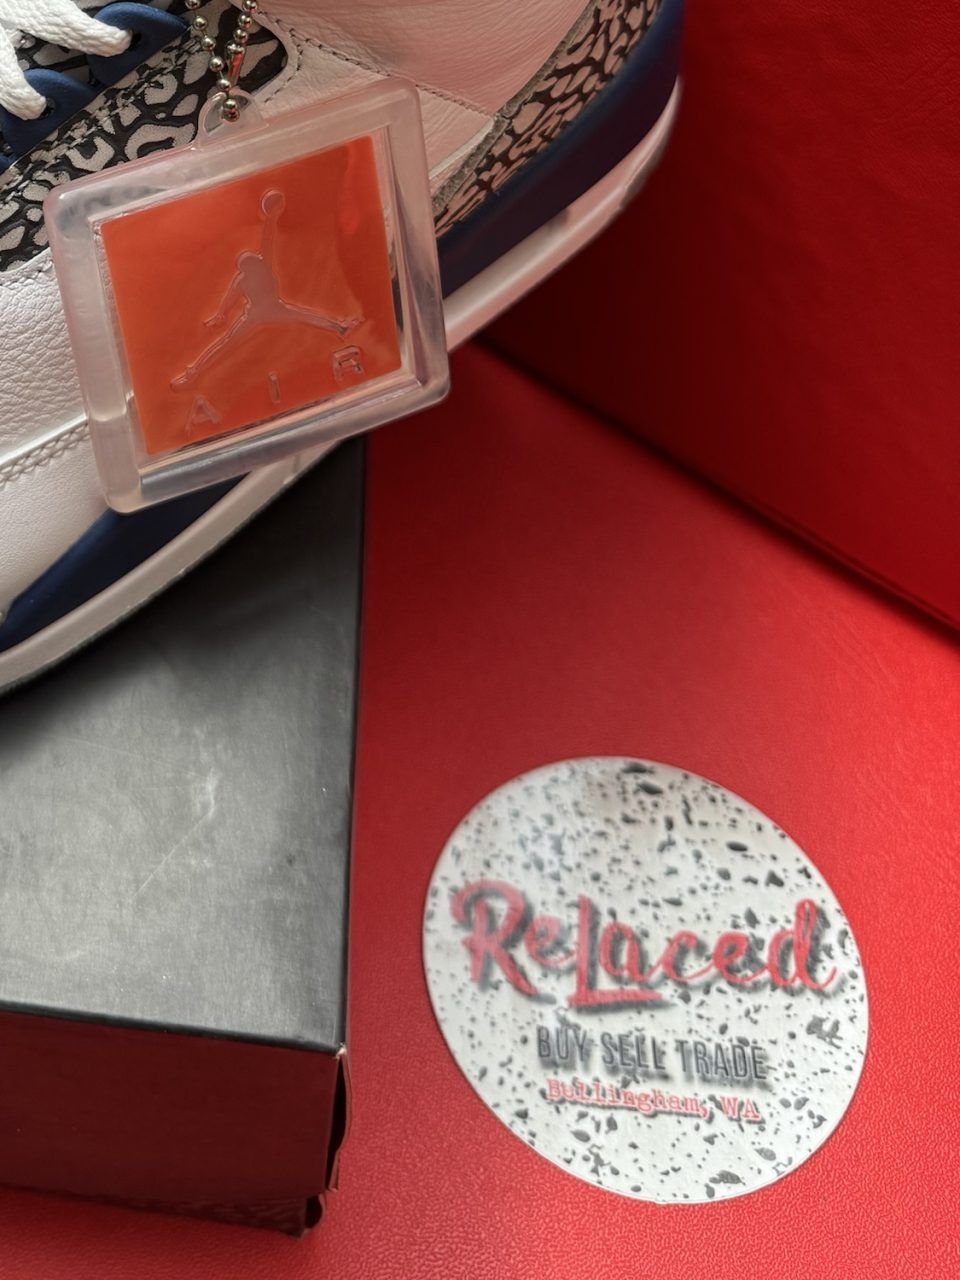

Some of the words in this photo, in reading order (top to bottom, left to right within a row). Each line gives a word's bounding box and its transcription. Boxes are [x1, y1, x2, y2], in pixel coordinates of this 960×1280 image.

[184, 345, 365, 438] AIR
[449, 878, 838, 1007] ReLaced
[536, 1025, 587, 1063] BUY
[600, 1031, 667, 1071] SELL
[675, 1038, 768, 1081] TRADE
[719, 1095, 761, 1120] WA
